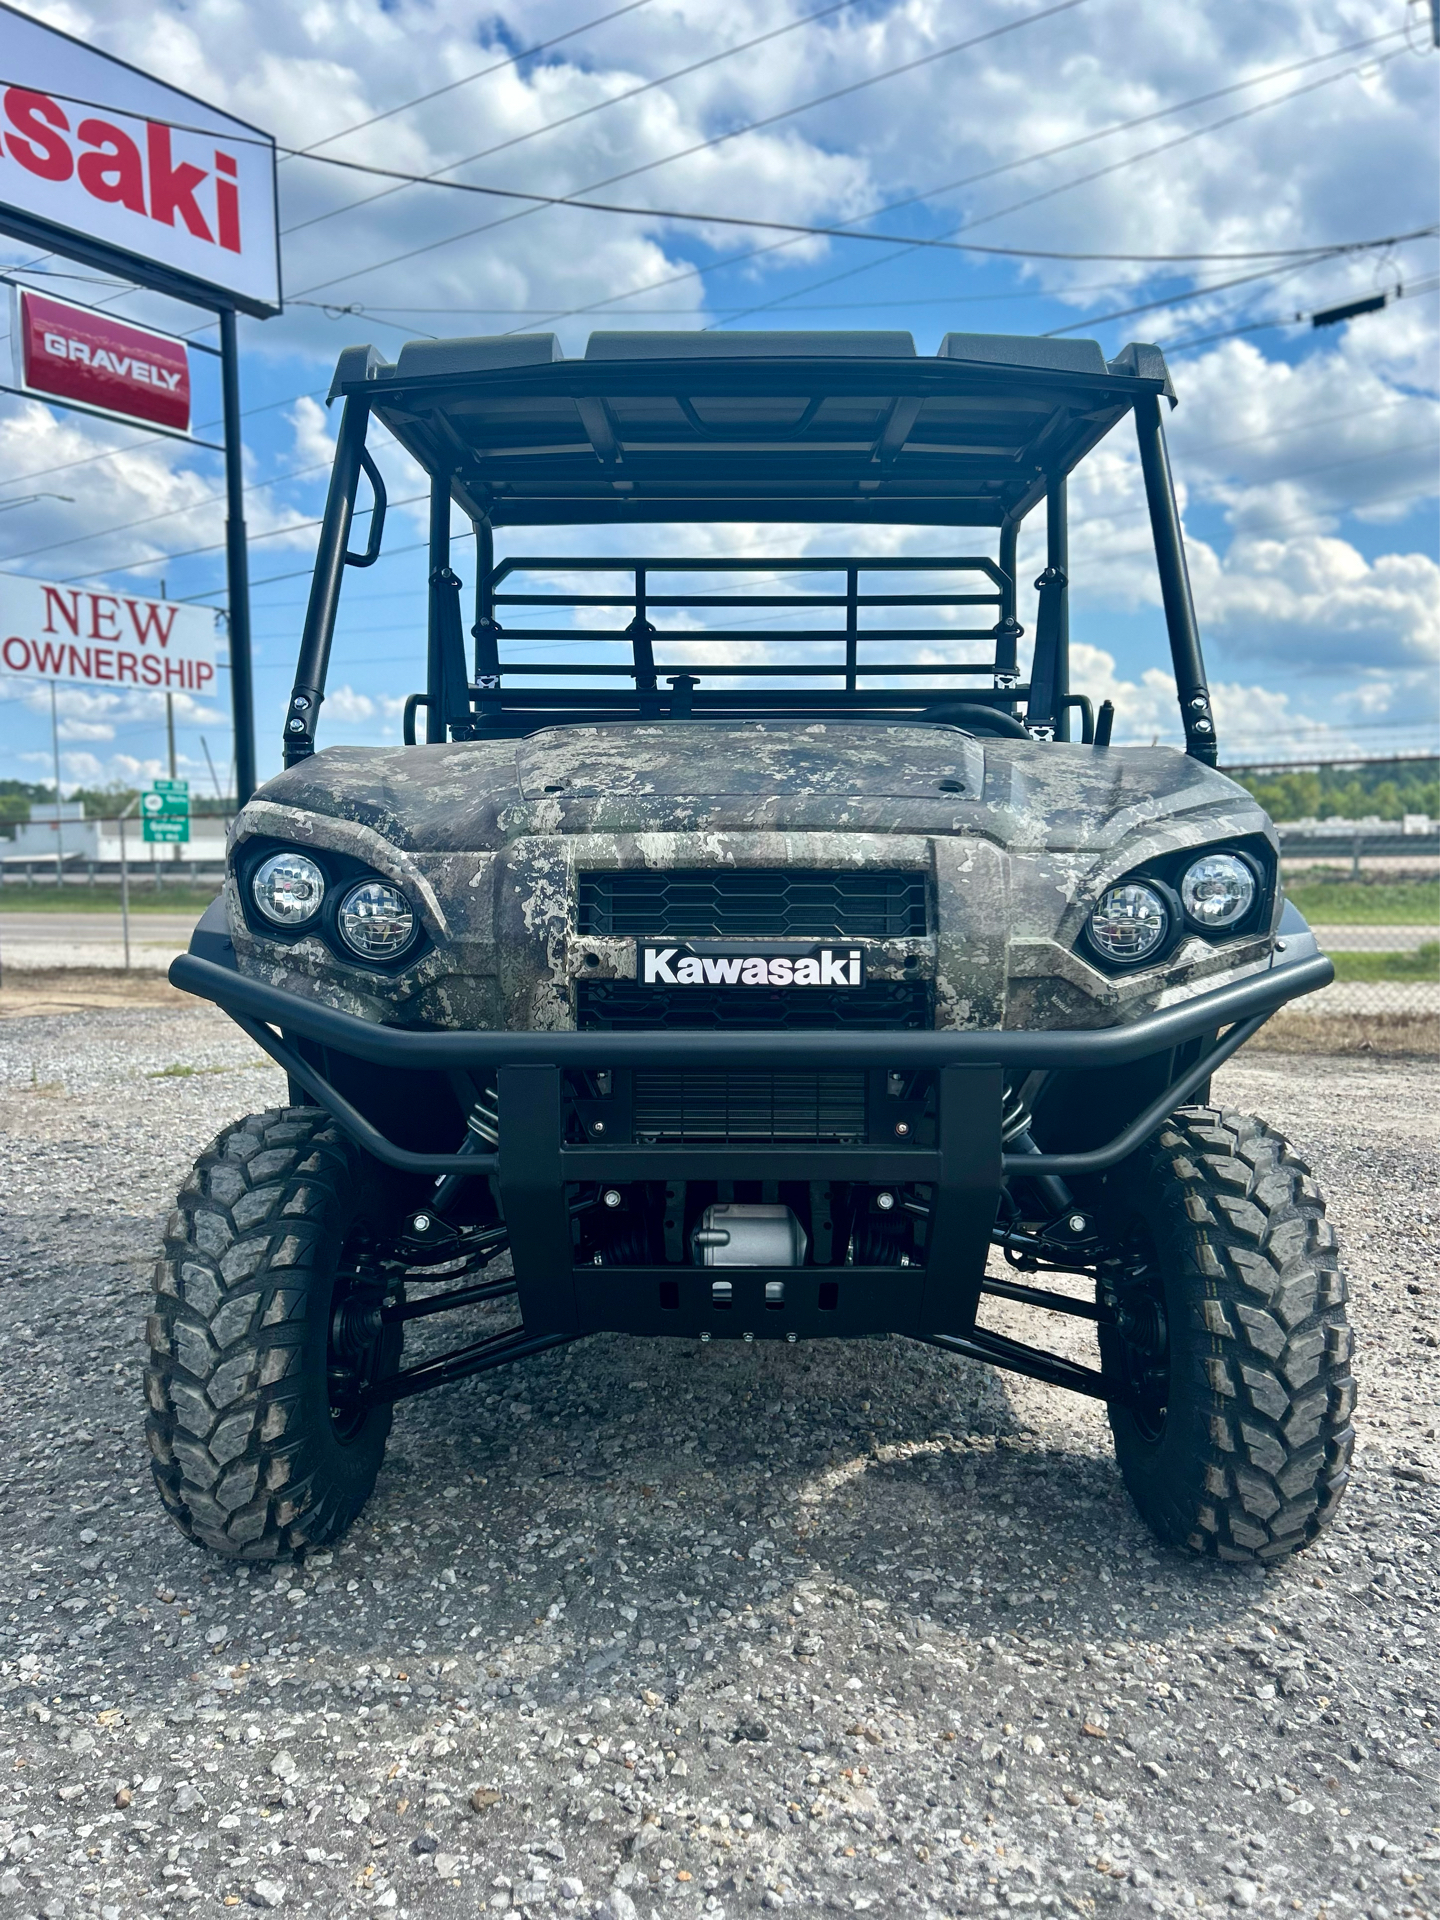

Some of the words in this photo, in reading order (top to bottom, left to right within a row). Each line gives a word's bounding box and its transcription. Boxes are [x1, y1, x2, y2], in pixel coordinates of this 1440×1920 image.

[0, 87, 241, 254] saki
[44, 332, 181, 391] GRAVELY
[40, 585, 179, 648] NEW
[2, 636, 214, 690] OWNERSHIP
[644, 949, 861, 985] Kawasaki
